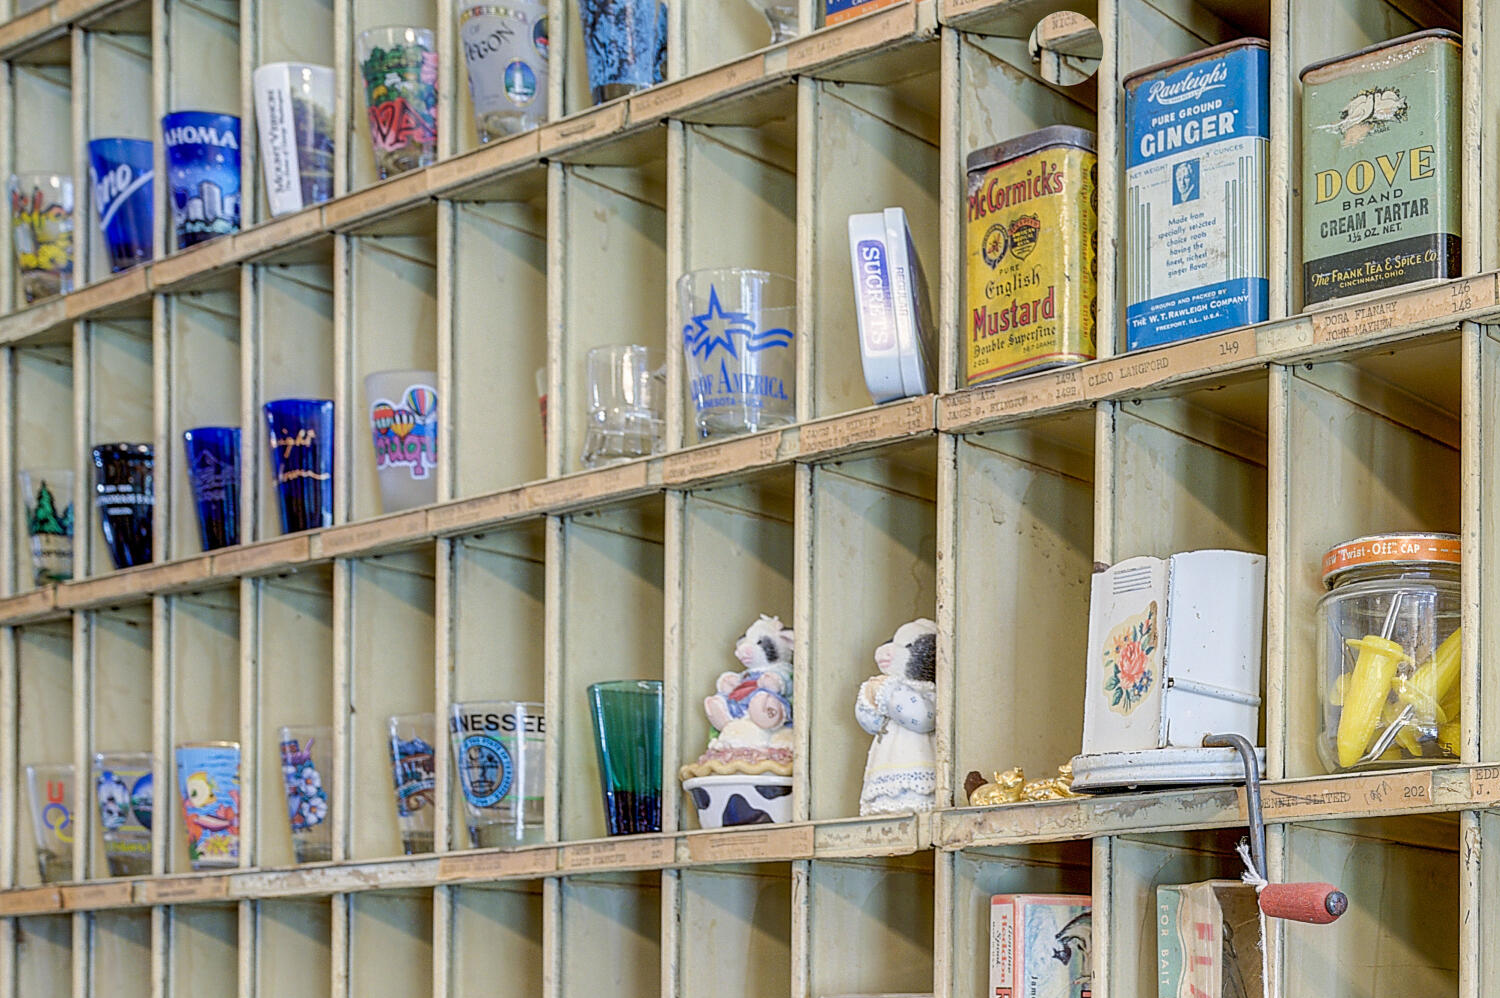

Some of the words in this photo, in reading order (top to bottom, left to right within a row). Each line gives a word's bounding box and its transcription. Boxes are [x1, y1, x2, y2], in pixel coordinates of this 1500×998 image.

[1152, 113, 1175, 128] PURE
[1179, 99, 1222, 120] GROUND
[1141, 111, 1235, 157] GINGER
[1315, 145, 1435, 205] DOVE
[1343, 189, 1403, 211] BRAND
[1168, 214, 1188, 226] Made
[1320, 211, 1366, 238] CREAM
[1375, 198, 1429, 226] TARTAR
[1193, 242, 1203, 251] the
[1312, 273, 1329, 287] The
[1452, 282, 1471, 297] 146
[863, 246, 887, 345] SUCRETS
[1178, 296, 1190, 304] AND
[1193, 291, 1216, 303] PACKED
[973, 285, 1055, 341] Mustard
[1133, 317, 1147, 328] THE
[1210, 295, 1249, 309] COMPANY
[1324, 310, 1350, 326] DORA
[1354, 301, 1397, 321] FLANARY
[1452, 299, 1471, 313] 148
[1325, 326, 1349, 342] JOHN
[1354, 318, 1393, 336] MAYHEW
[1087, 374, 1114, 388] CLEO
[1120, 357, 1170, 381] LANGFORD
[1220, 341, 1239, 356] 149
[1401, 544, 1420, 554] CAP
[1404, 785, 1425, 798] 202
[1476, 784, 1490, 795] J.
[1161, 904, 1169, 937] FOR
[1161, 949, 1169, 985] BAIT
